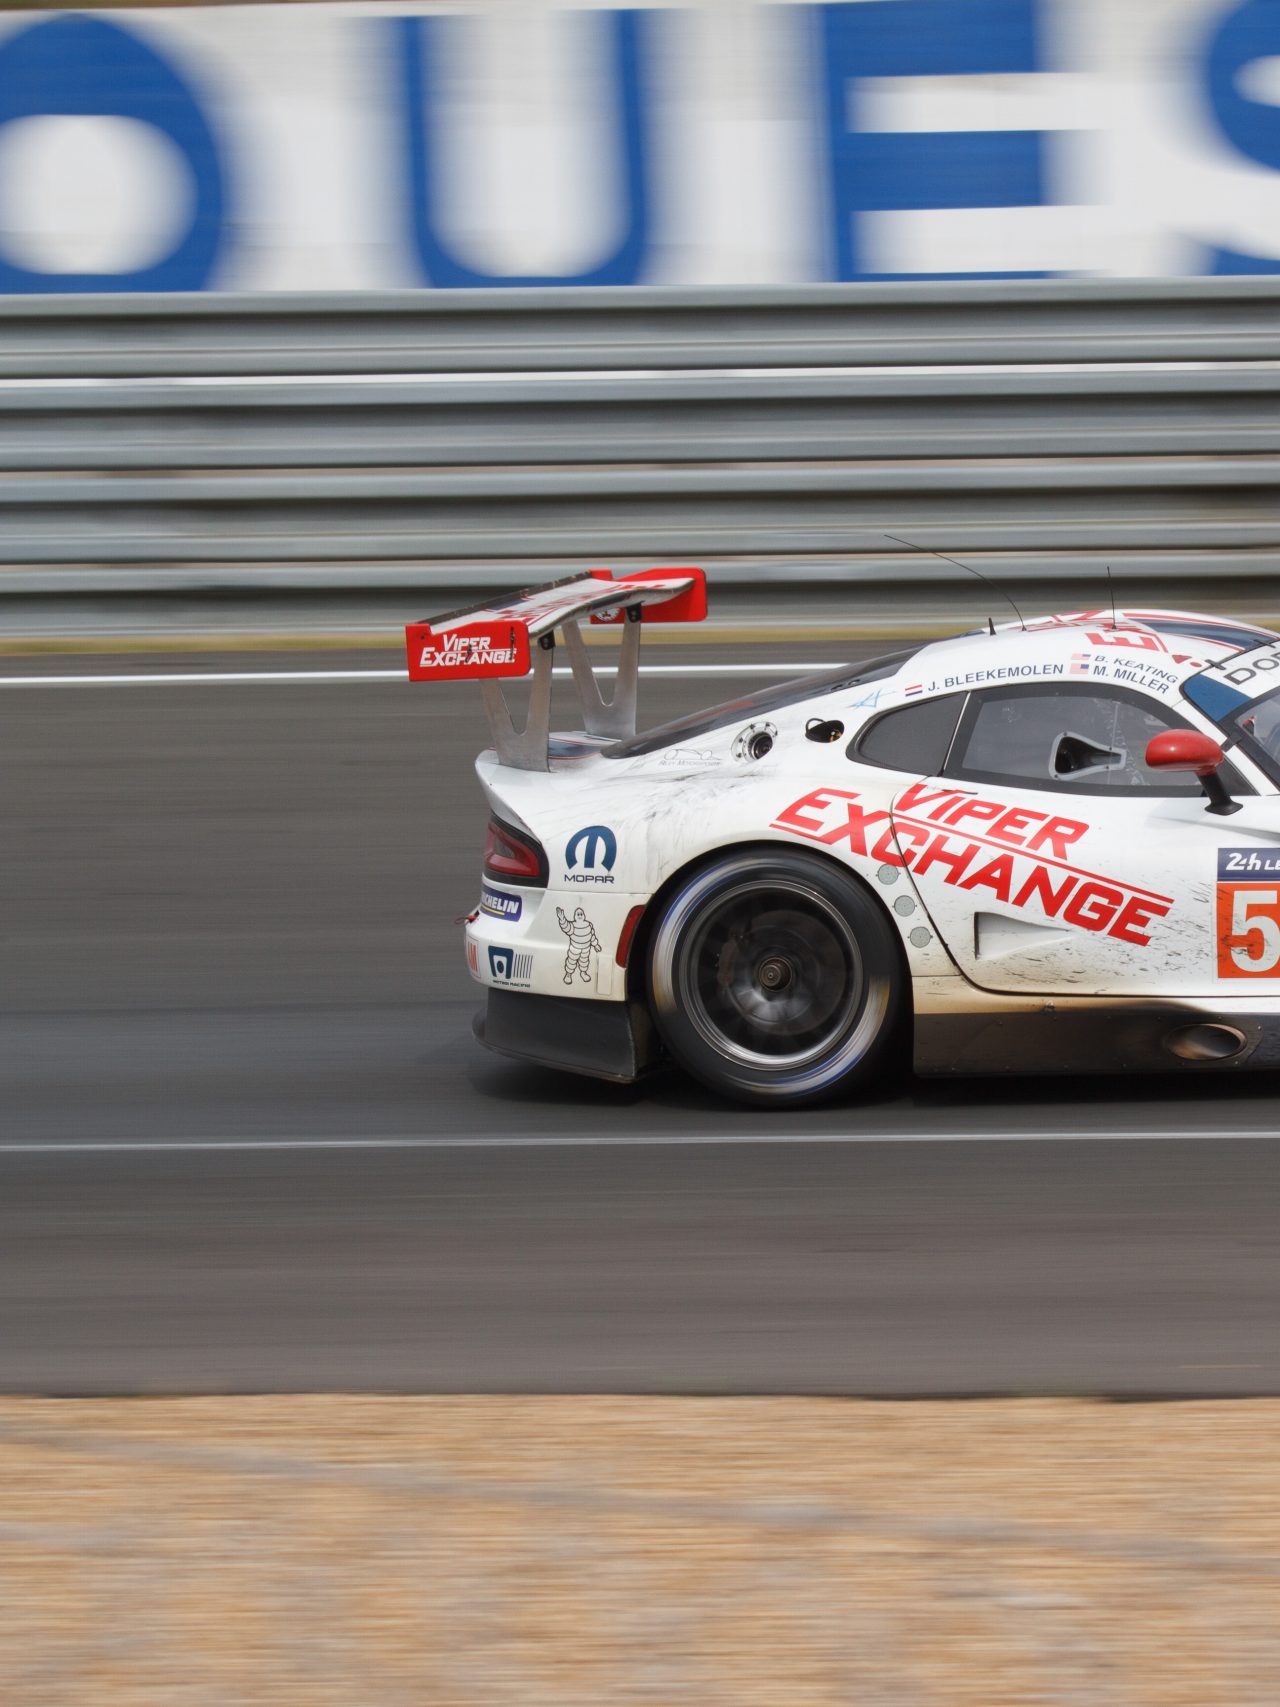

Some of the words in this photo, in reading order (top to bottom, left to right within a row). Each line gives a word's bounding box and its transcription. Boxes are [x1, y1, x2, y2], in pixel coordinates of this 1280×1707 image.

[419, 646, 517, 667] EXCHANGE
[443, 633, 491, 651] VIPER
[927, 680, 941, 692] J.
[944, 663, 1064, 689] BLEEKEMOLEN
[1093, 665, 1109, 677] M.
[1119, 666, 1170, 695] MILLER
[1094, 654, 1106, 663] B.
[1113, 657, 1179, 684] KEATING
[893, 783, 1090, 861] VIPER
[769, 787, 1174, 947] EXCHANGE
[1225, 852, 1262, 871] 24h
[563, 874, 616, 885] MOPAR
